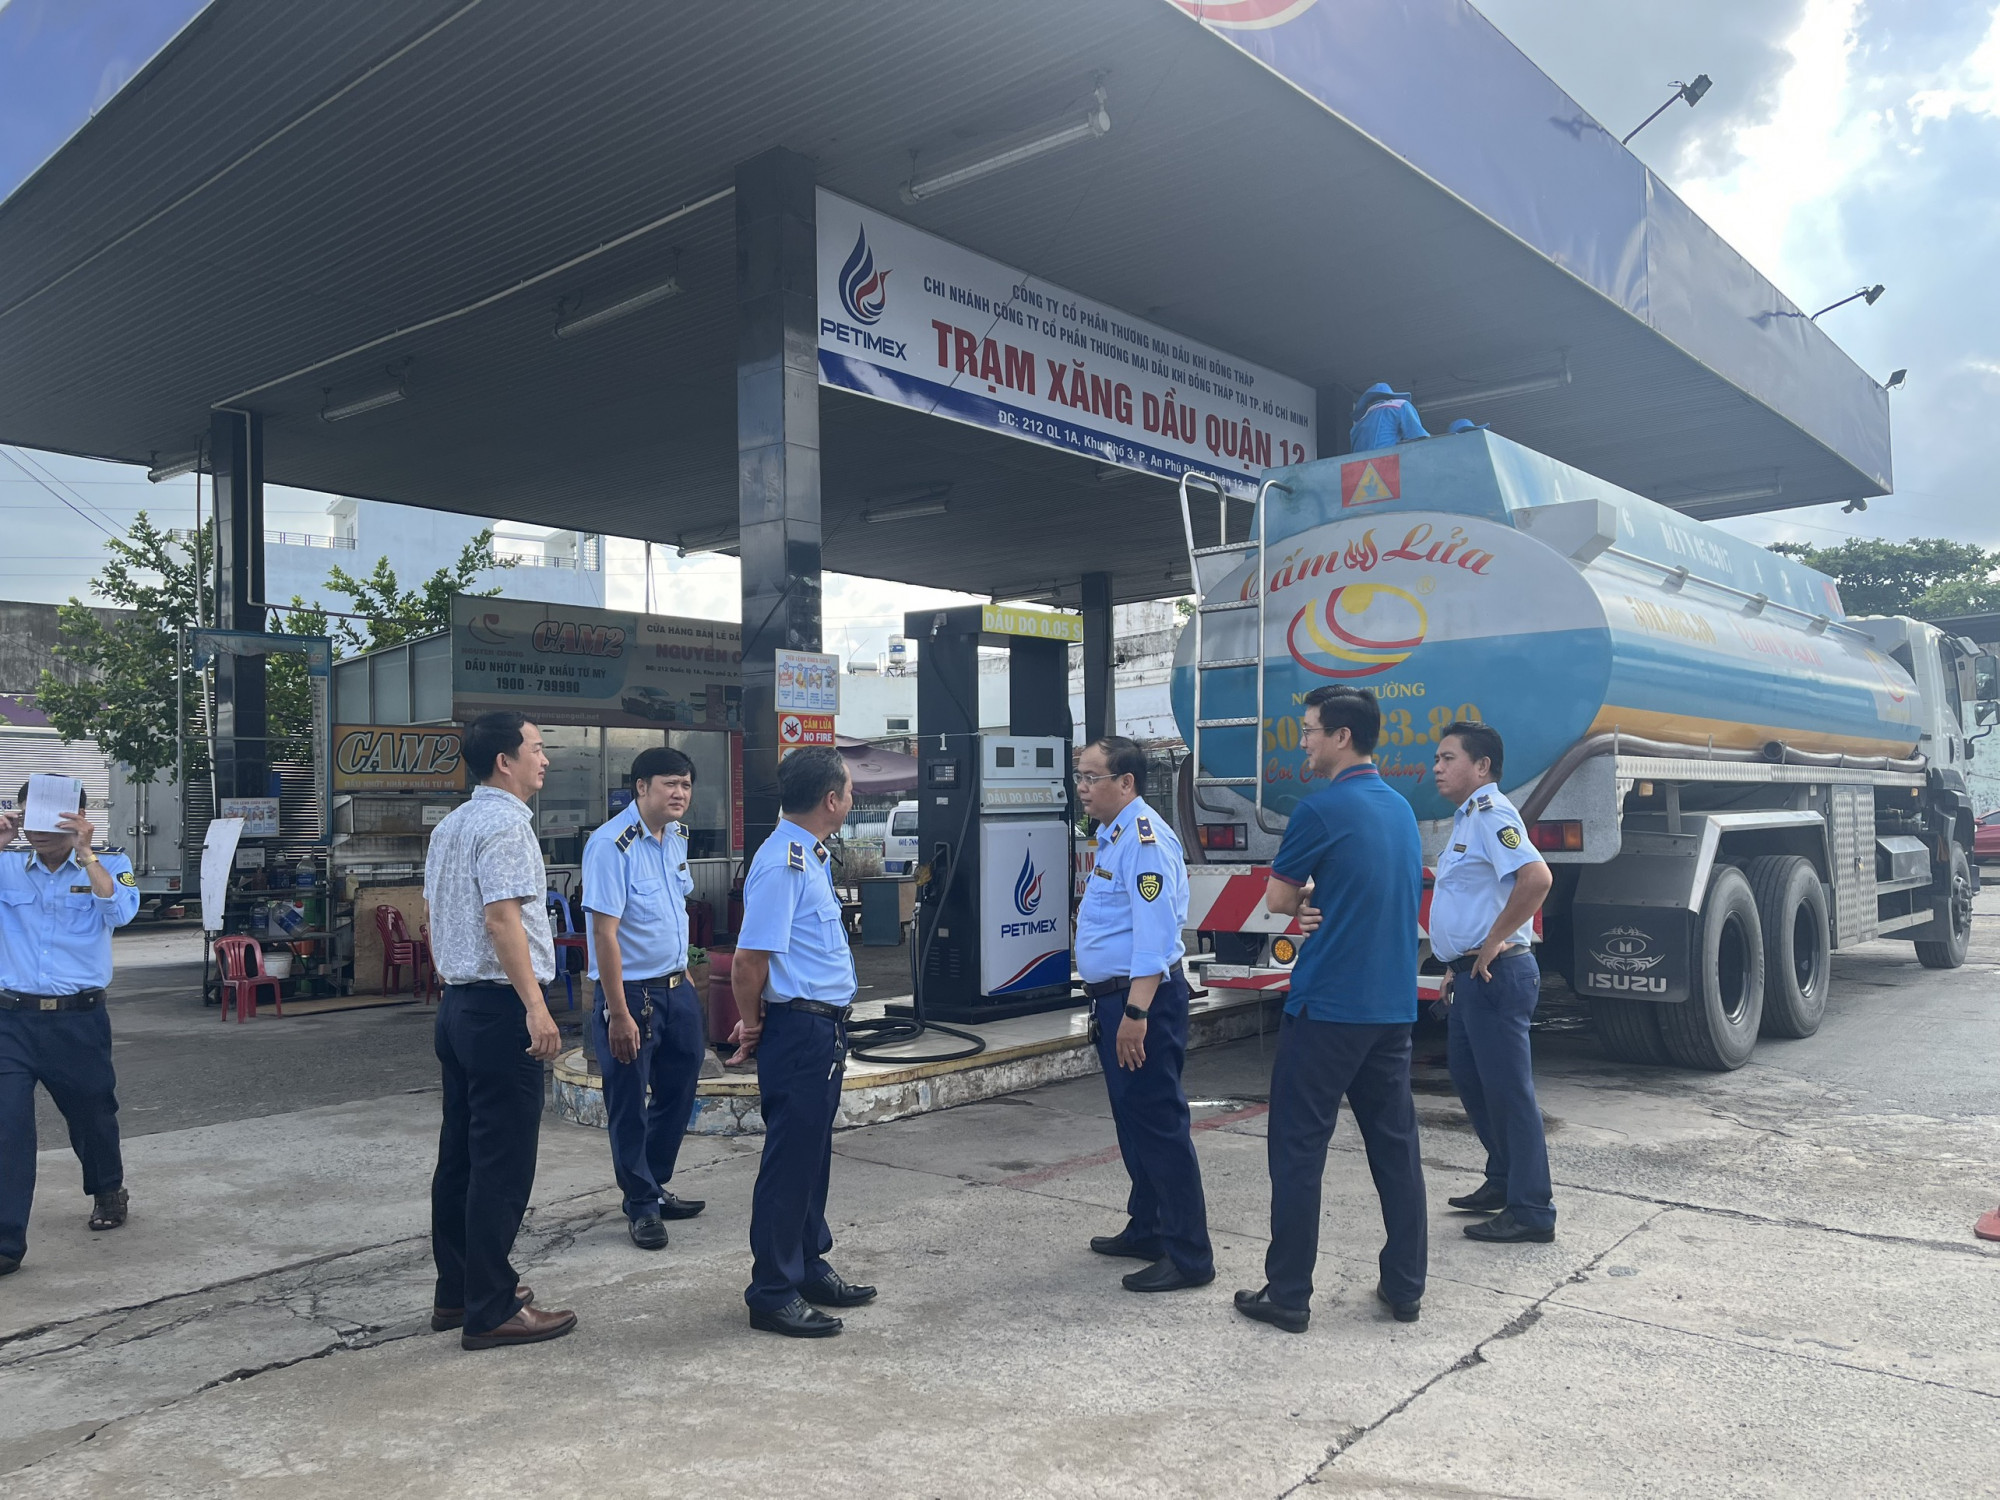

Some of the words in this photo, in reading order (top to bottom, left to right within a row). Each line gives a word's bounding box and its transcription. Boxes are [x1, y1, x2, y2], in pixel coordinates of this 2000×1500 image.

[820, 317, 908, 362] PETIMEX
[1012, 284, 1043, 309] CÔNG
[1046, 297, 1059, 315] TY
[1062, 302, 1077, 321] CỔ
[1111, 322, 1149, 349] THƯƠNG
[1151, 338, 1169, 358] MẠI
[1192, 353, 1207, 369] KHÍ
[1234, 369, 1255, 388] THÁP
[924, 275, 946, 298] CHI
[949, 288, 990, 314] NHÁNH
[993, 301, 1023, 327] CÔNG
[1026, 314, 1039, 332] TY
[1043, 318, 1057, 338] CỔ
[1090, 337, 1129, 364] THƯƠNG
[1131, 353, 1149, 373] MẠI
[1171, 368, 1186, 385] KHÍ
[1213, 382, 1234, 401] THÁP
[1236, 391, 1248, 408] TẠI
[1275, 406, 1288, 421] CHÍ
[1290, 412, 1309, 428] MINH
[931, 318, 1036, 396] TRẠM
[1046, 358, 1133, 426] XĂNG
[1142, 387, 1197, 445] DẦU
[1205, 414, 1272, 470] QUẬN
[1279, 439, 1305, 467] 12
[998, 410, 1019, 427] ĐC:
[1022, 418, 1044, 434] 212
[1046, 424, 1061, 439] QL
[1064, 430, 1081, 447] 1A,
[1084, 435, 1103, 451] Khu
[1106, 442, 1125, 457] Phố
[1127, 448, 1136, 463] 3,
[1138, 451, 1149, 464] P.
[1150, 455, 1162, 467] An
[1165, 458, 1182, 473] Phú
[1382, 522, 1495, 576] Lửa
[646, 623, 665, 633] CỬA
[668, 625, 693, 636] HÀNG
[985, 608, 1014, 632] DẦU
[1018, 617, 1036, 634] DO
[1041, 619, 1069, 637] 0.05
[1073, 622, 1082, 639] S
[532, 620, 626, 658] CAM2
[465, 657, 486, 671] DẦU
[489, 660, 516, 673] NHỚT
[519, 662, 545, 676] NHẬP
[549, 663, 574, 677] KHẨU
[496, 677, 525, 690] 1900
[536, 679, 580, 693] 799990
[803, 716, 817, 729] CẤM
[819, 717, 832, 729] LỬA
[803, 732, 814, 742] NO
[816, 733, 832, 743] FIRE
[939, 732, 948, 750] 1
[336, 731, 462, 775] CAM2
[987, 788, 1007, 804] DẦU
[1024, 791, 1043, 803] 0.05
[1001, 918, 1057, 938] PETIMEX
[1588, 972, 1667, 993] ISUZU
